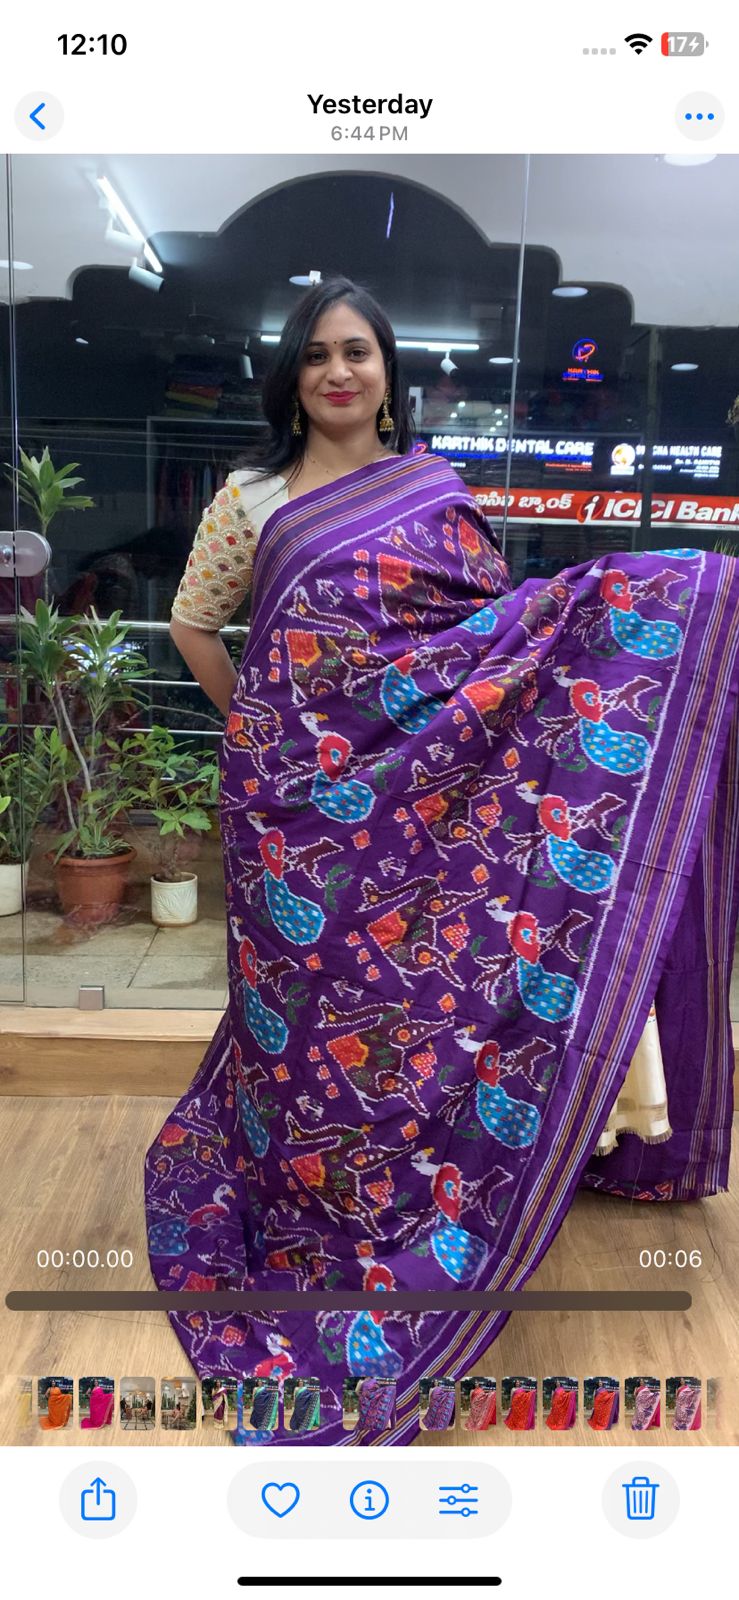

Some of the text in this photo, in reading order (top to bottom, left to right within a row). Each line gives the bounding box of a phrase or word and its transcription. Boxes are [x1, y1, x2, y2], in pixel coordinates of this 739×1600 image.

[432, 436, 595, 456] KARTHIK DENTAL CARE
[669, 446, 700, 456] HEALTH
[701, 446, 723, 458] CARE
[519, 494, 574, 513] బ్యాంక్
[603, 498, 675, 519] ICICI
